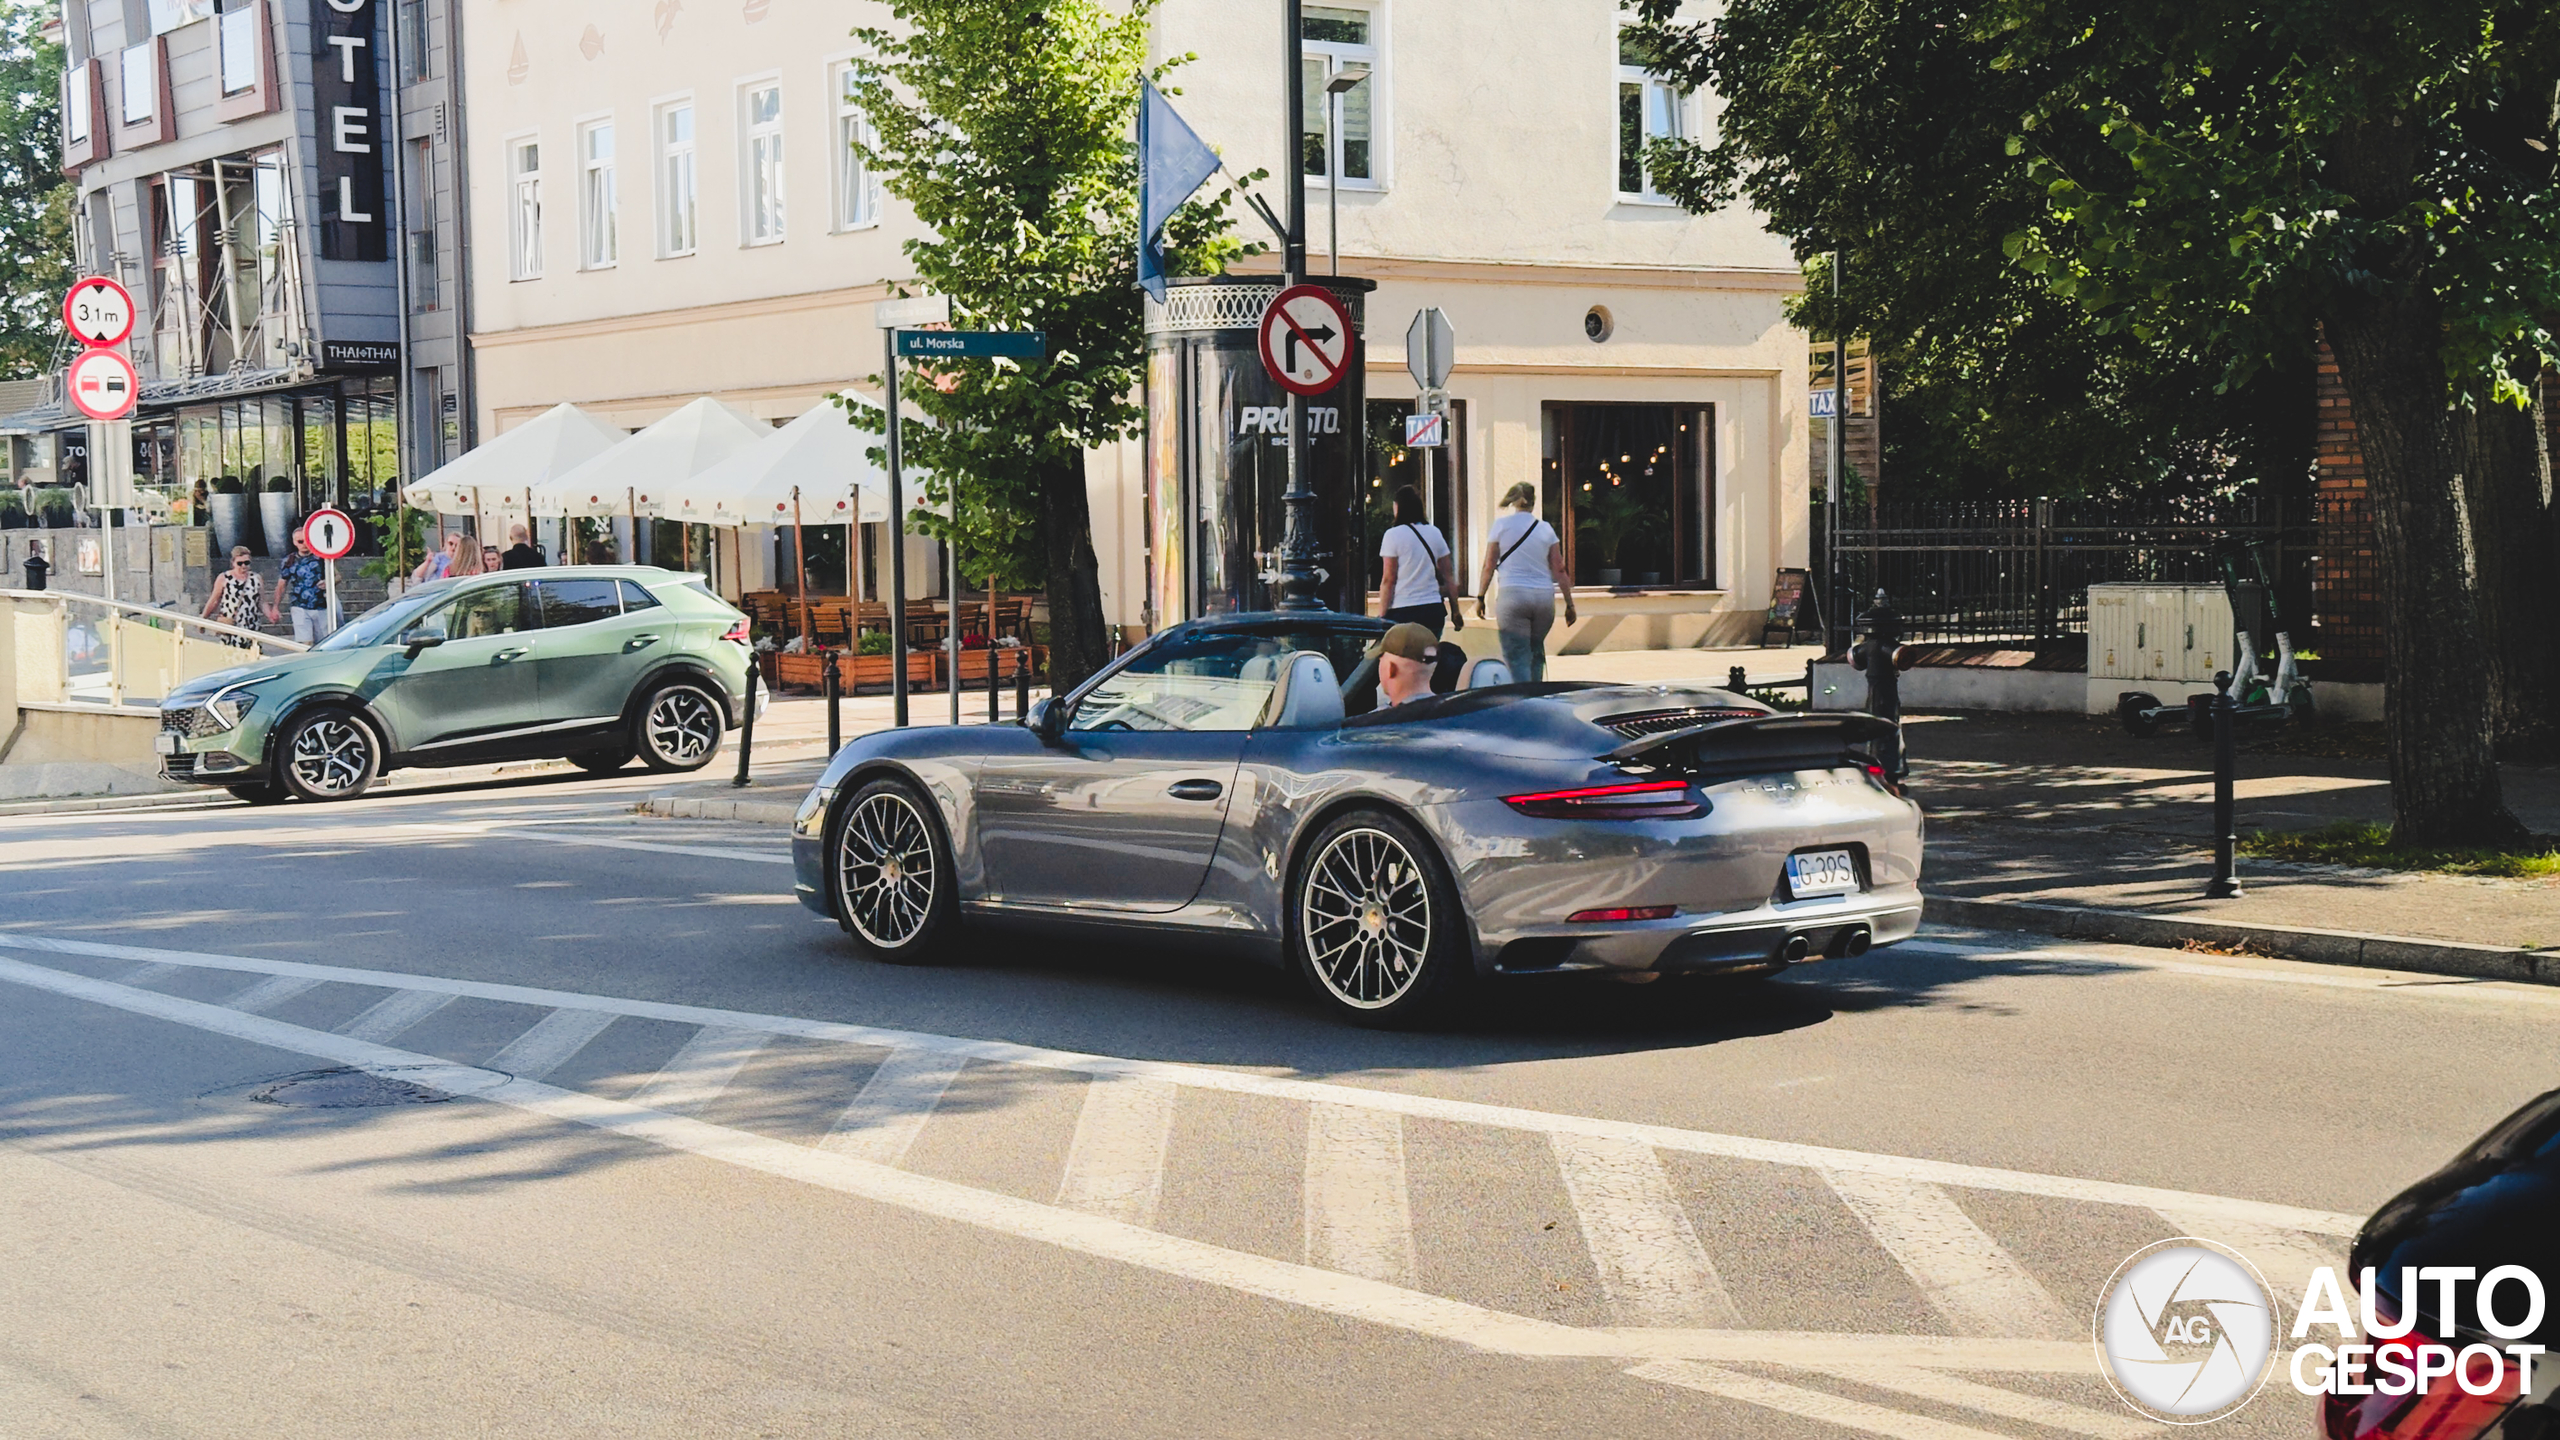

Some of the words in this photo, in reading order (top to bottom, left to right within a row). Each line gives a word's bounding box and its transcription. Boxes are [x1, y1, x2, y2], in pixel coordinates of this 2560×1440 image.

[78, 303, 100, 323] 3,1
[104, 312, 119, 323] m
[327, 345, 360, 359] THAI
[365, 346, 397, 360] THAI
[909, 337, 924, 349] ul.
[926, 337, 965, 349] Morska
[1809, 392, 1838, 415] TAX
[1408, 419, 1438, 442] TAXI
[1798, 858, 1812, 886] G
